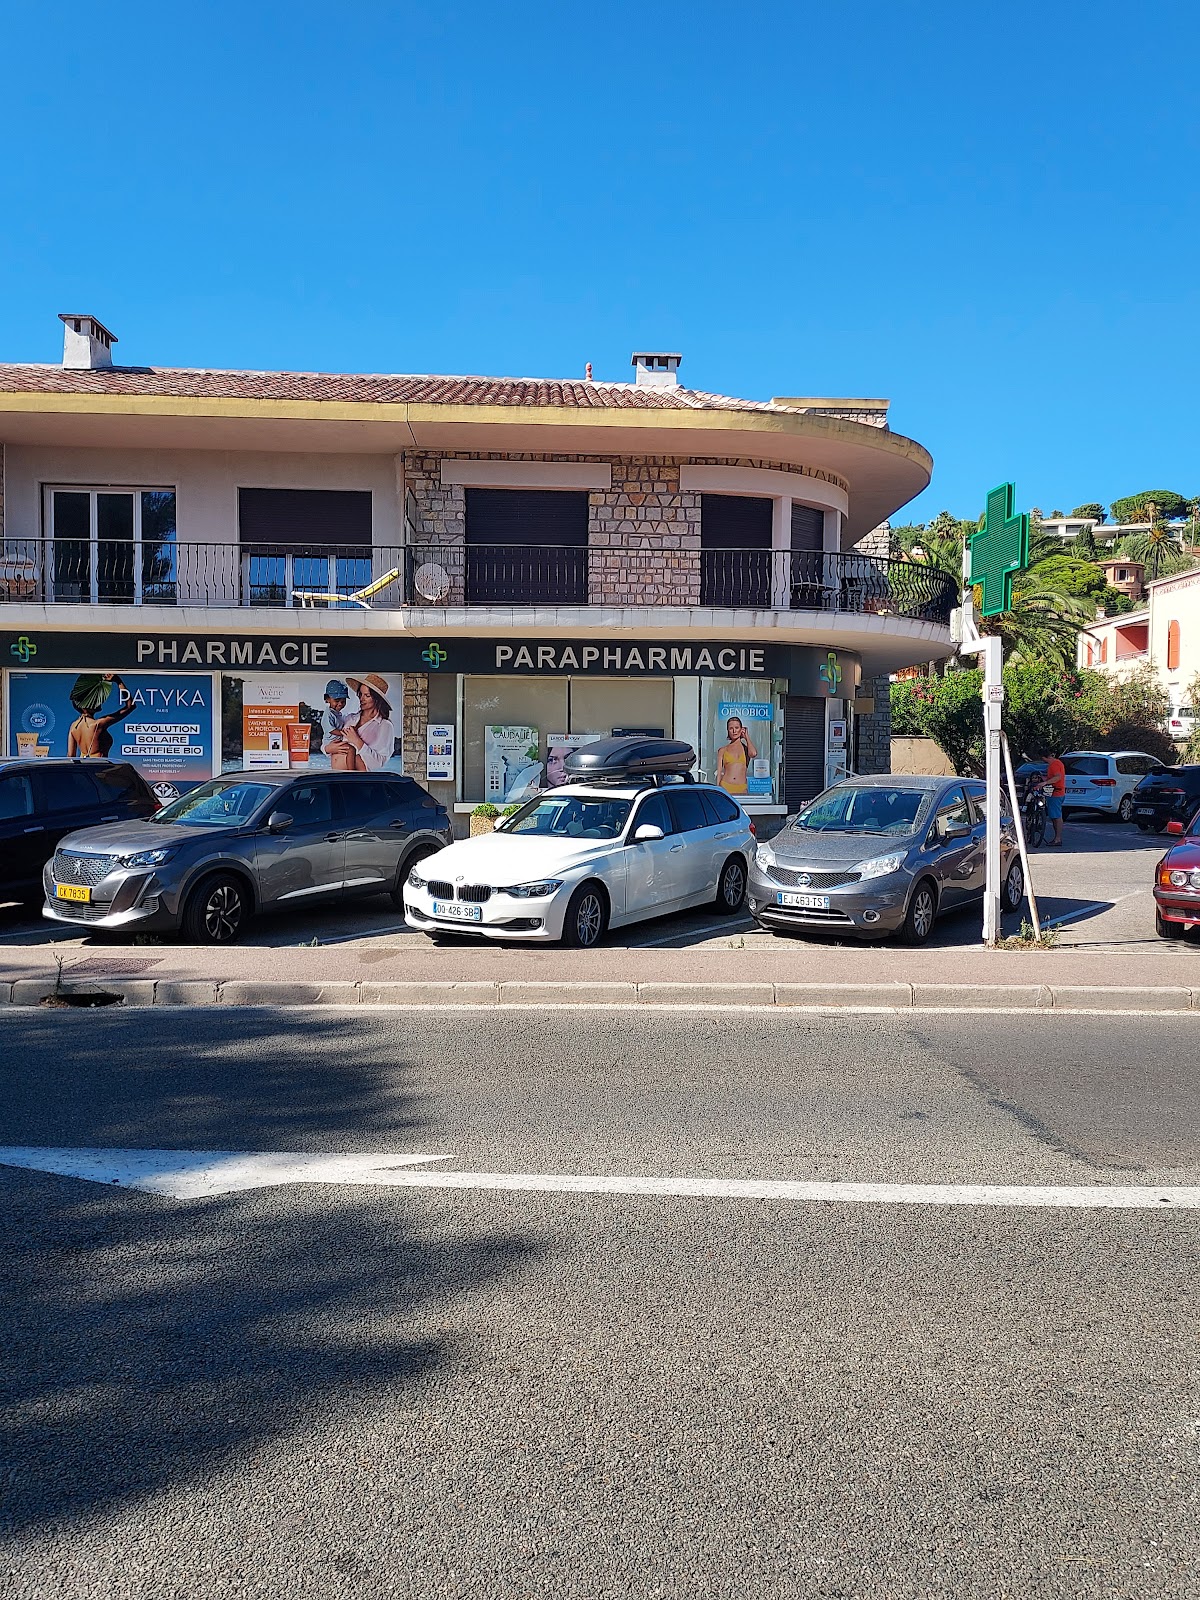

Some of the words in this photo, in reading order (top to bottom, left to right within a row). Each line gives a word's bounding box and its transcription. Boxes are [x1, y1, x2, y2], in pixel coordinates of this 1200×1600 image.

[136, 639, 329, 667] PHARMACIE
[495, 645, 765, 672] PARAPHARMACIE
[119, 688, 206, 707] PATYKA
[721, 707, 769, 718] OENOBIOL
[127, 723, 198, 733] RÉVOLUTION
[138, 736, 187, 744] SOLAIRE
[123, 745, 181, 755] CERTIFIÉE
[183, 747, 202, 755] BIO
[60, 887, 67, 897] CK
[69, 888, 86, 900] 7835
[783, 894, 823, 907] EJ-463-TS
